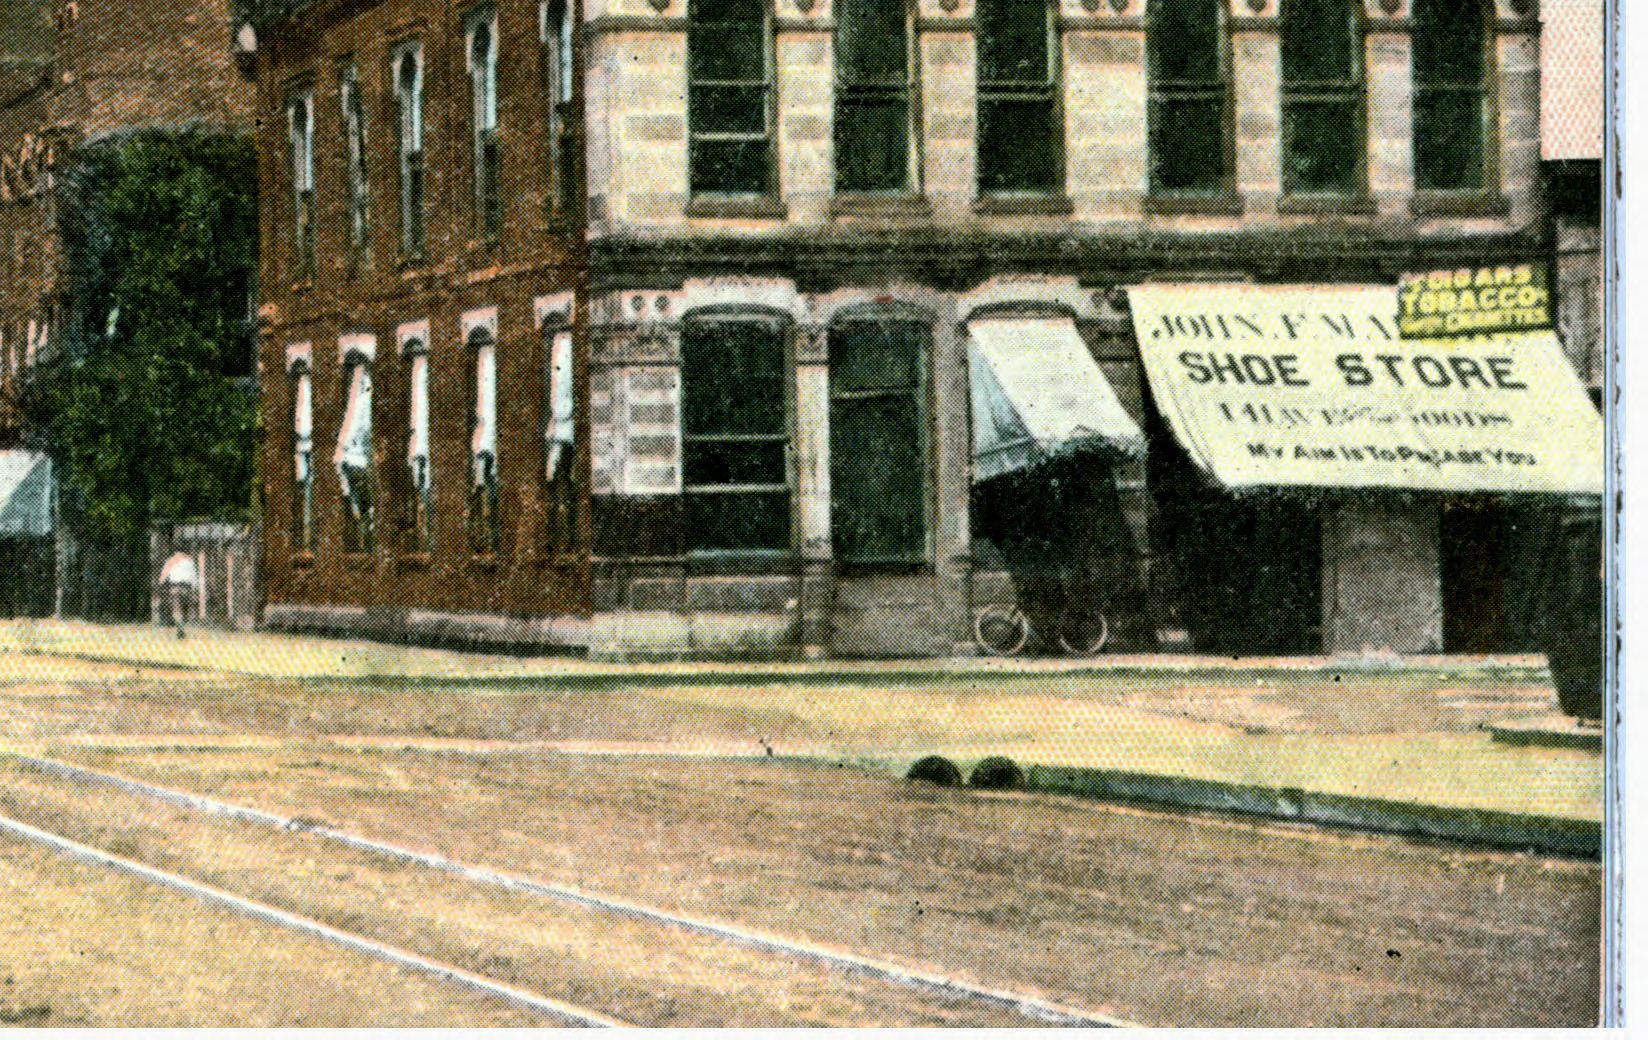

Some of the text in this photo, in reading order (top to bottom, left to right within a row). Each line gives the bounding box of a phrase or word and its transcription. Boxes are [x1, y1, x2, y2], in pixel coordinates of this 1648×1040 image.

[1401, 285, 1537, 315] TOBACCO
[1178, 350, 1527, 391] SHOE STORE
